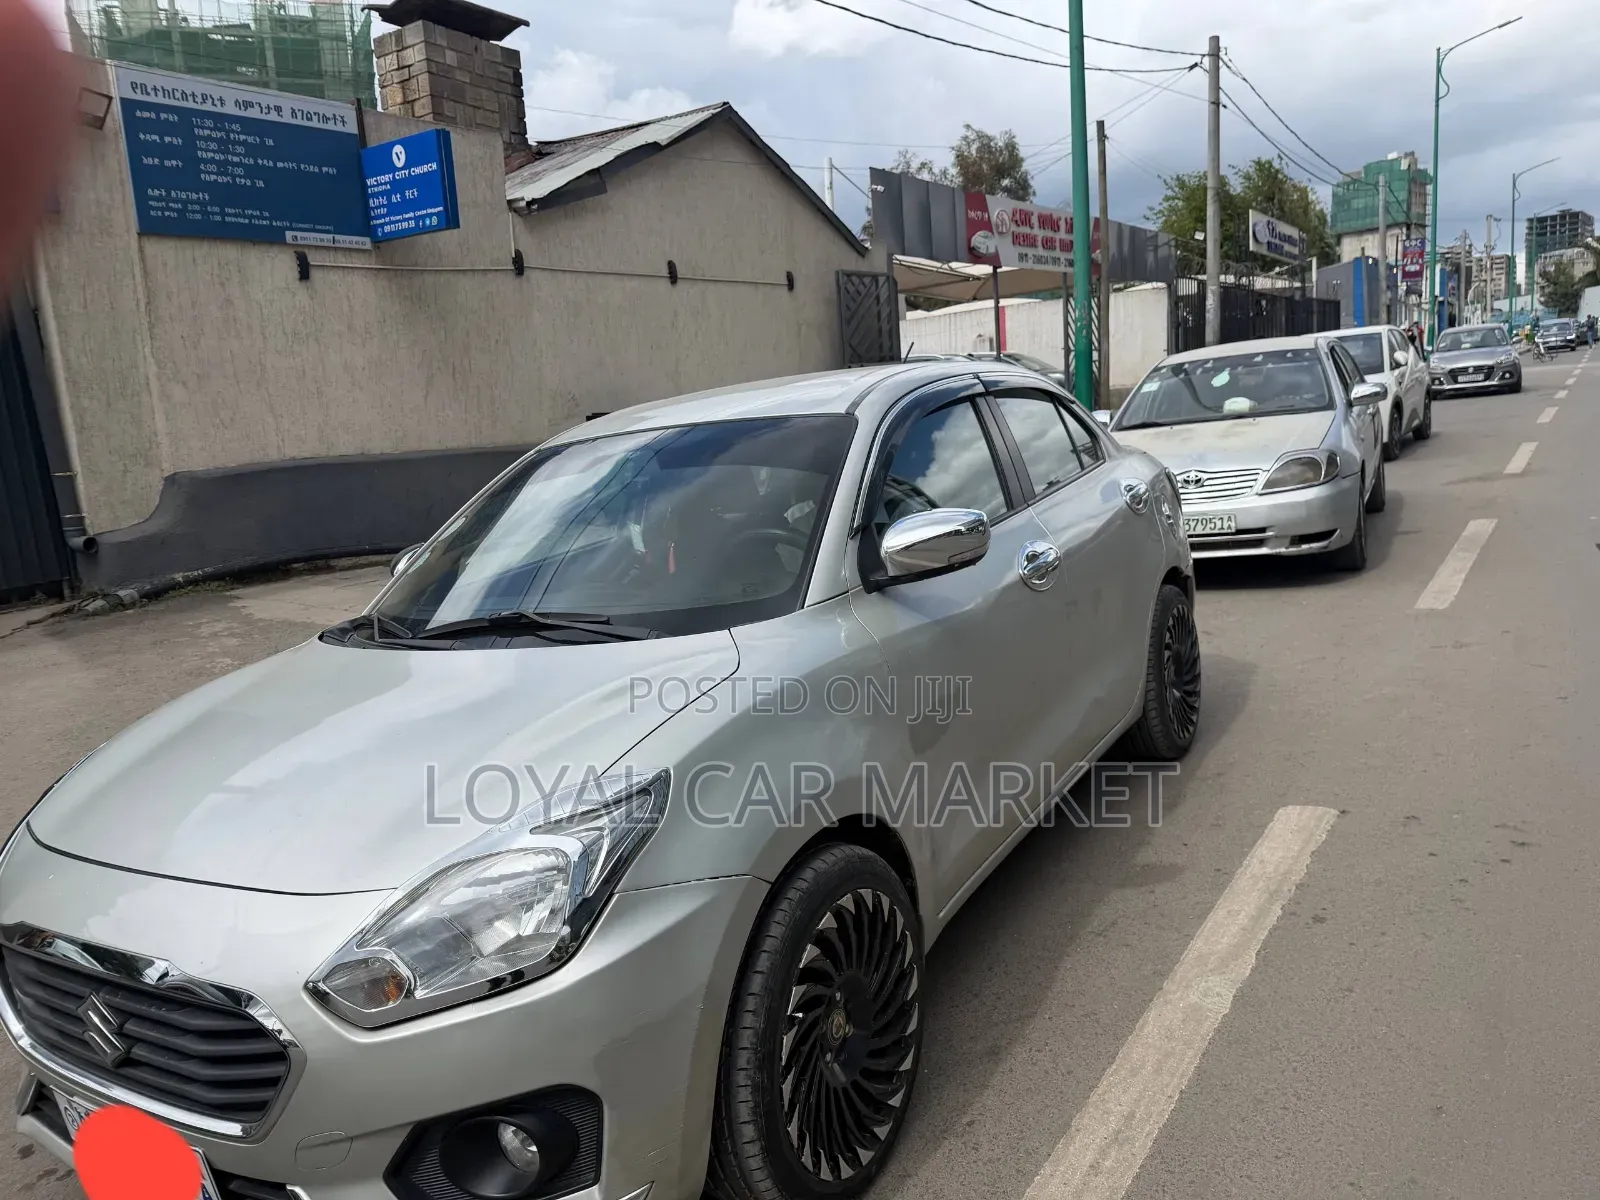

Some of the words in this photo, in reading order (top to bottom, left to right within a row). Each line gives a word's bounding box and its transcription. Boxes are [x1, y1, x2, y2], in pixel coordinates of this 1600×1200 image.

[192, 117, 214, 128] 11:30
[225, 122, 241, 132] 1:45
[196, 140, 218, 150] 10:30
[228, 144, 245, 154] 1:30
[199, 163, 217, 172] 4:00
[227, 166, 245, 175] 7:00
[366, 173, 393, 186] VICTORY
[395, 169, 410, 180] CITY
[410, 162, 437, 176] CHURCH
[368, 183, 391, 194] ETHIOPIA
